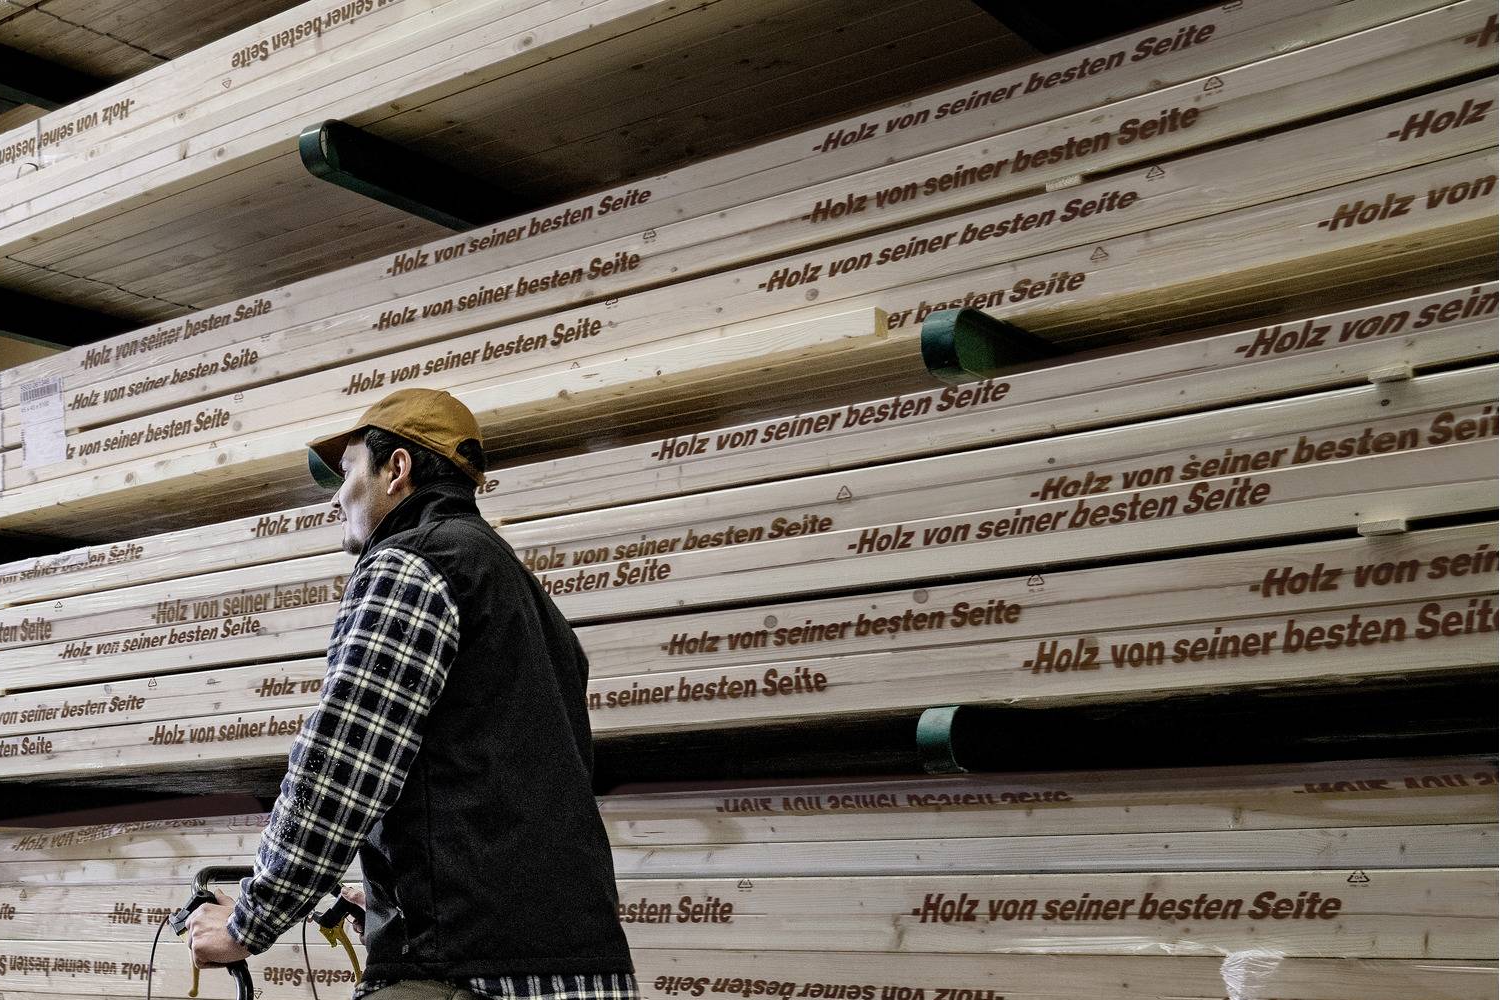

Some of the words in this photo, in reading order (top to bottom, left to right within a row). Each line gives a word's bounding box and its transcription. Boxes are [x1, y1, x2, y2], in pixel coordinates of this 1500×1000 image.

[884, 109, 930, 134] von
[934, 81, 1022, 121] seiner
[1023, 53, 1124, 96] besten
[1130, 22, 1216, 63] Seite
[875, 183, 919, 208] von
[923, 158, 1010, 197] seiner
[1010, 133, 1111, 175] besten
[1116, 105, 1202, 145] Seite
[1426, 174, 1498, 210] von
[434, 243, 464, 264] von
[467, 226, 526, 254] seiner
[527, 208, 593, 238] besten
[597, 188, 651, 217] Seite
[828, 254, 872, 278] von
[876, 230, 959, 266] seiner
[959, 208, 1056, 247] besten
[1060, 189, 1139, 223] Seite
[421, 298, 453, 319] von
[457, 281, 513, 312] seiner
[516, 267, 582, 299] besten
[587, 251, 640, 280] Seite
[1009, 270, 1085, 304] Seite
[115, 340, 138, 360] von
[139, 326, 182, 352] seiner
[183, 313, 231, 340] besten
[233, 299, 272, 322] Seite
[1338, 310, 1410, 343] von
[389, 363, 420, 385] von
[423, 346, 480, 376] seiner
[481, 332, 546, 362] besten
[549, 317, 601, 347] Seite
[103, 384, 126, 403] von
[128, 371, 170, 396] seiner
[170, 358, 218, 385] besten
[221, 348, 259, 374] Seite
[79, 440, 100, 457] von
[103, 430, 144, 452] seiner
[145, 418, 193, 444] besten
[195, 408, 230, 436] Seite
[715, 428, 758, 451] von
[760, 412, 842, 444] seiner
[843, 395, 932, 431] besten
[935, 379, 1011, 413] Seite
[1122, 463, 1174, 490] von
[1179, 447, 1288, 482] seiner
[1291, 428, 1419, 465] besten
[295, 512, 323, 528] von
[923, 519, 969, 547] von
[975, 504, 1070, 540] seiner
[1068, 489, 1178, 530] besten
[1182, 478, 1270, 516] Seite
[572, 545, 612, 565] von
[614, 535, 680, 561] seiner
[683, 519, 763, 550] besten
[767, 514, 833, 539] Seite
[612, 559, 671, 587] Seite
[1354, 558, 1419, 588] von
[192, 600, 219, 620] von
[222, 589, 270, 615] seiner
[274, 584, 328, 609] besten
[20, 617, 52, 640] Seite
[95, 641, 119, 655] von
[122, 629, 167, 650] seiner
[168, 624, 218, 644] besten
[220, 618, 261, 639] Seite
[727, 630, 768, 651] von
[772, 618, 852, 646] seiner
[855, 608, 945, 640] besten
[949, 599, 1021, 629] Seite
[1110, 640, 1164, 668] von
[1172, 628, 1277, 662] seiner
[1282, 615, 1406, 654] besten
[605, 682, 674, 708] seiner
[677, 675, 758, 703] besten
[761, 666, 827, 697] Seite
[19, 704, 59, 724] seiner
[61, 698, 106, 719] besten
[108, 695, 145, 713] Seite
[22, 737, 52, 755] Seite
[190, 725, 215, 742] von
[218, 717, 264, 740] seiner
[677, 896, 734, 923] Seite
[988, 898, 1036, 920] von
[1041, 893, 1134, 921] seiner
[1138, 893, 1242, 921] besten
[1248, 891, 1342, 920] Seite
[264, 966, 301, 986] Seite
[654, 975, 709, 998] Seite
[711, 977, 796, 1000] besten
